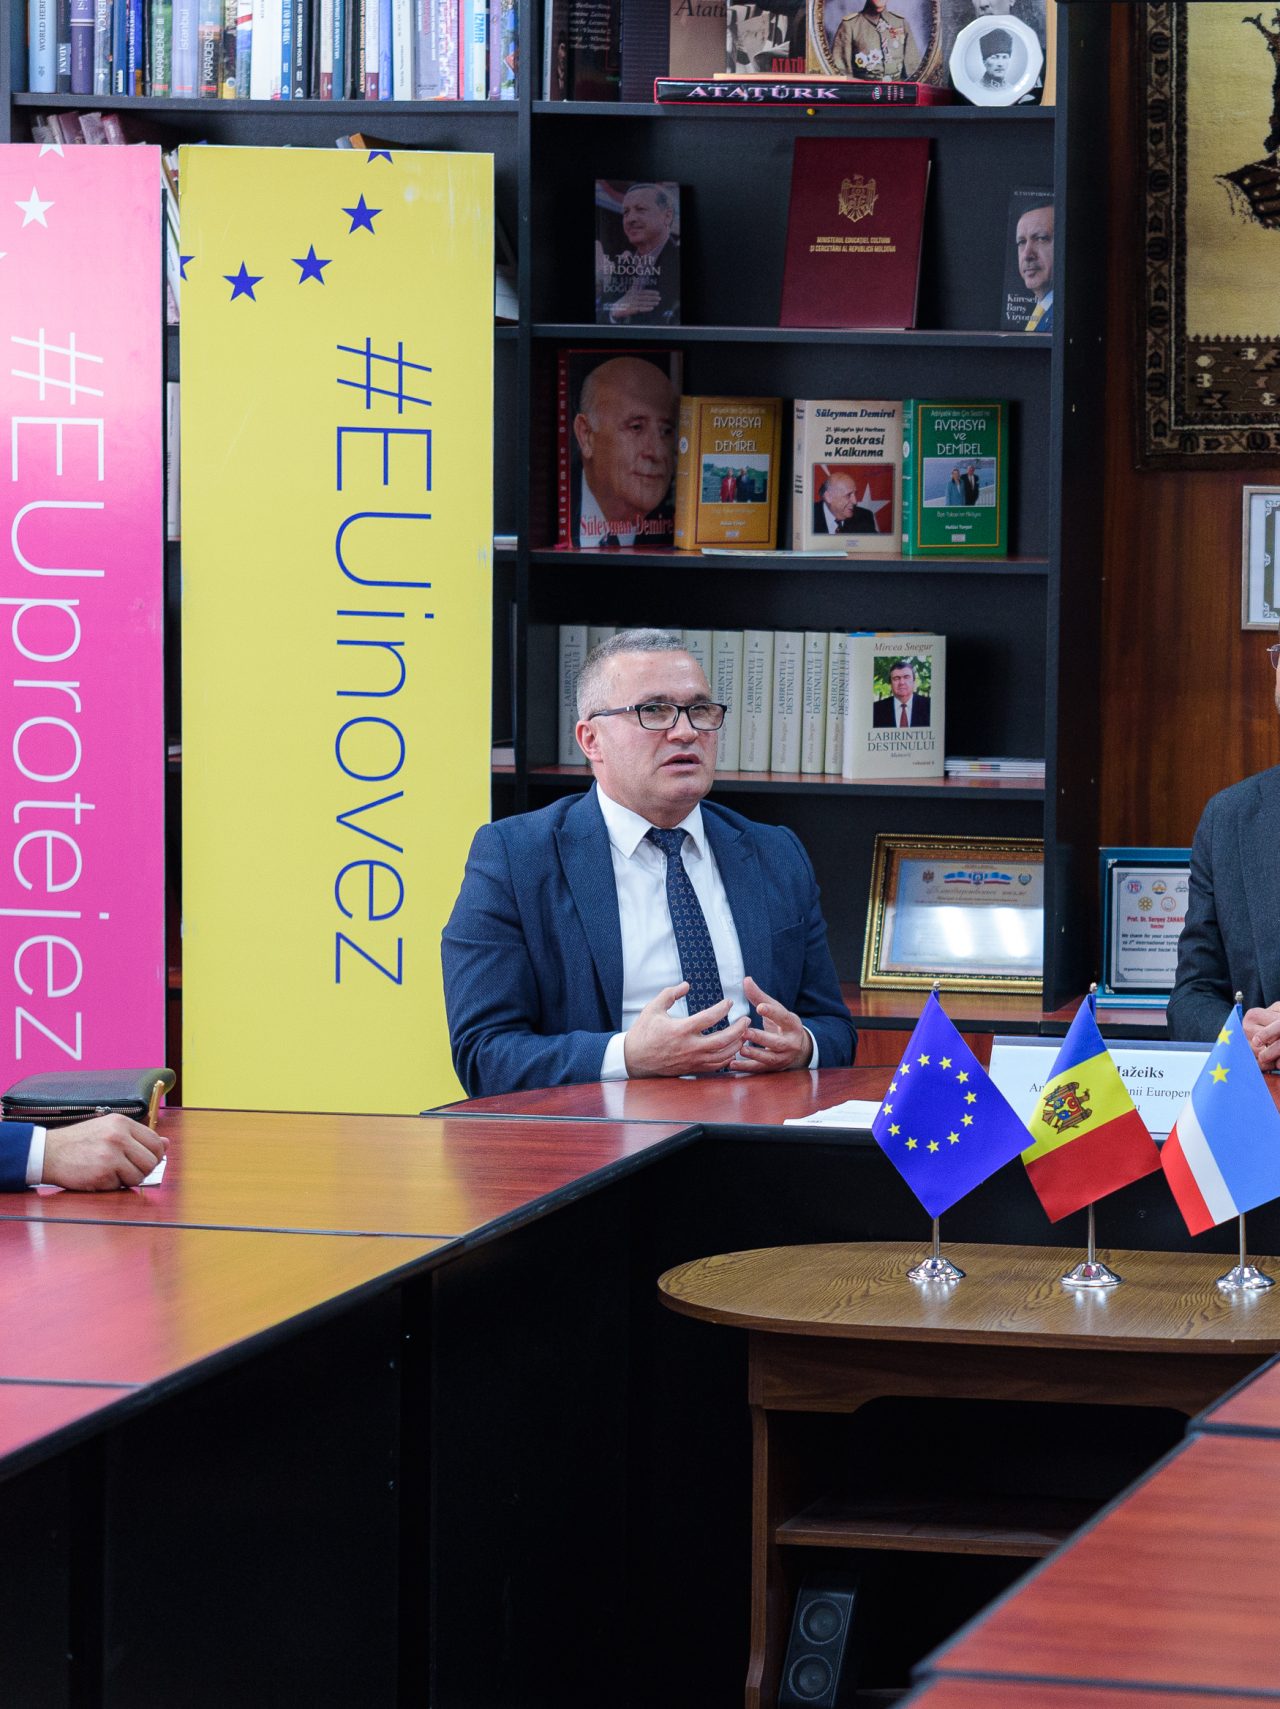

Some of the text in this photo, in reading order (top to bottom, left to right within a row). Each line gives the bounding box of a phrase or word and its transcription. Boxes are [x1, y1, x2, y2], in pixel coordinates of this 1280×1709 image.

[39, 29, 47, 52] WORLD
[59, 45, 67, 74] ADANA
[687, 85, 841, 101] ATATÜRK
[713, 416, 762, 428] AVRASYA
[815, 408, 896, 420] Süleyman Demirel
[935, 419, 986, 431] AVRASYA
[715, 439, 757, 452] DEMİREL
[731, 430, 743, 438] ve
[825, 434, 885, 445] Demokrasi
[834, 447, 884, 457] Kalkınma
[937, 442, 983, 455] DEMİREL
[559, 447, 567, 537] Süleyman
[634, 513, 674, 536] Demire
[874, 642, 934, 653] Mircea Snegur
[335, 336, 434, 986] #EUinovez
[564, 651, 572, 707] LABIRINTUL
[717, 658, 726, 706] ABIRINTUL
[724, 658, 734, 714] DESTINULUI
[746, 657, 756, 713] LABIRINTUL
[754, 658, 764, 714] DESTINULUI
[778, 658, 787, 715] LABIRINTUL
[785, 658, 795, 715] DESTINULUI
[805, 658, 814, 714] LABIRINTUL
[813, 658, 822, 715] DESTINULUI
[830, 659, 839, 715] LABIRINTUL
[0, 327, 109, 1061] #EUprotejez
[867, 730, 936, 742] LABIRINTUL
[867, 741, 935, 752] DESTINULUI
[1146, 1086, 1191, 1099] Europen
